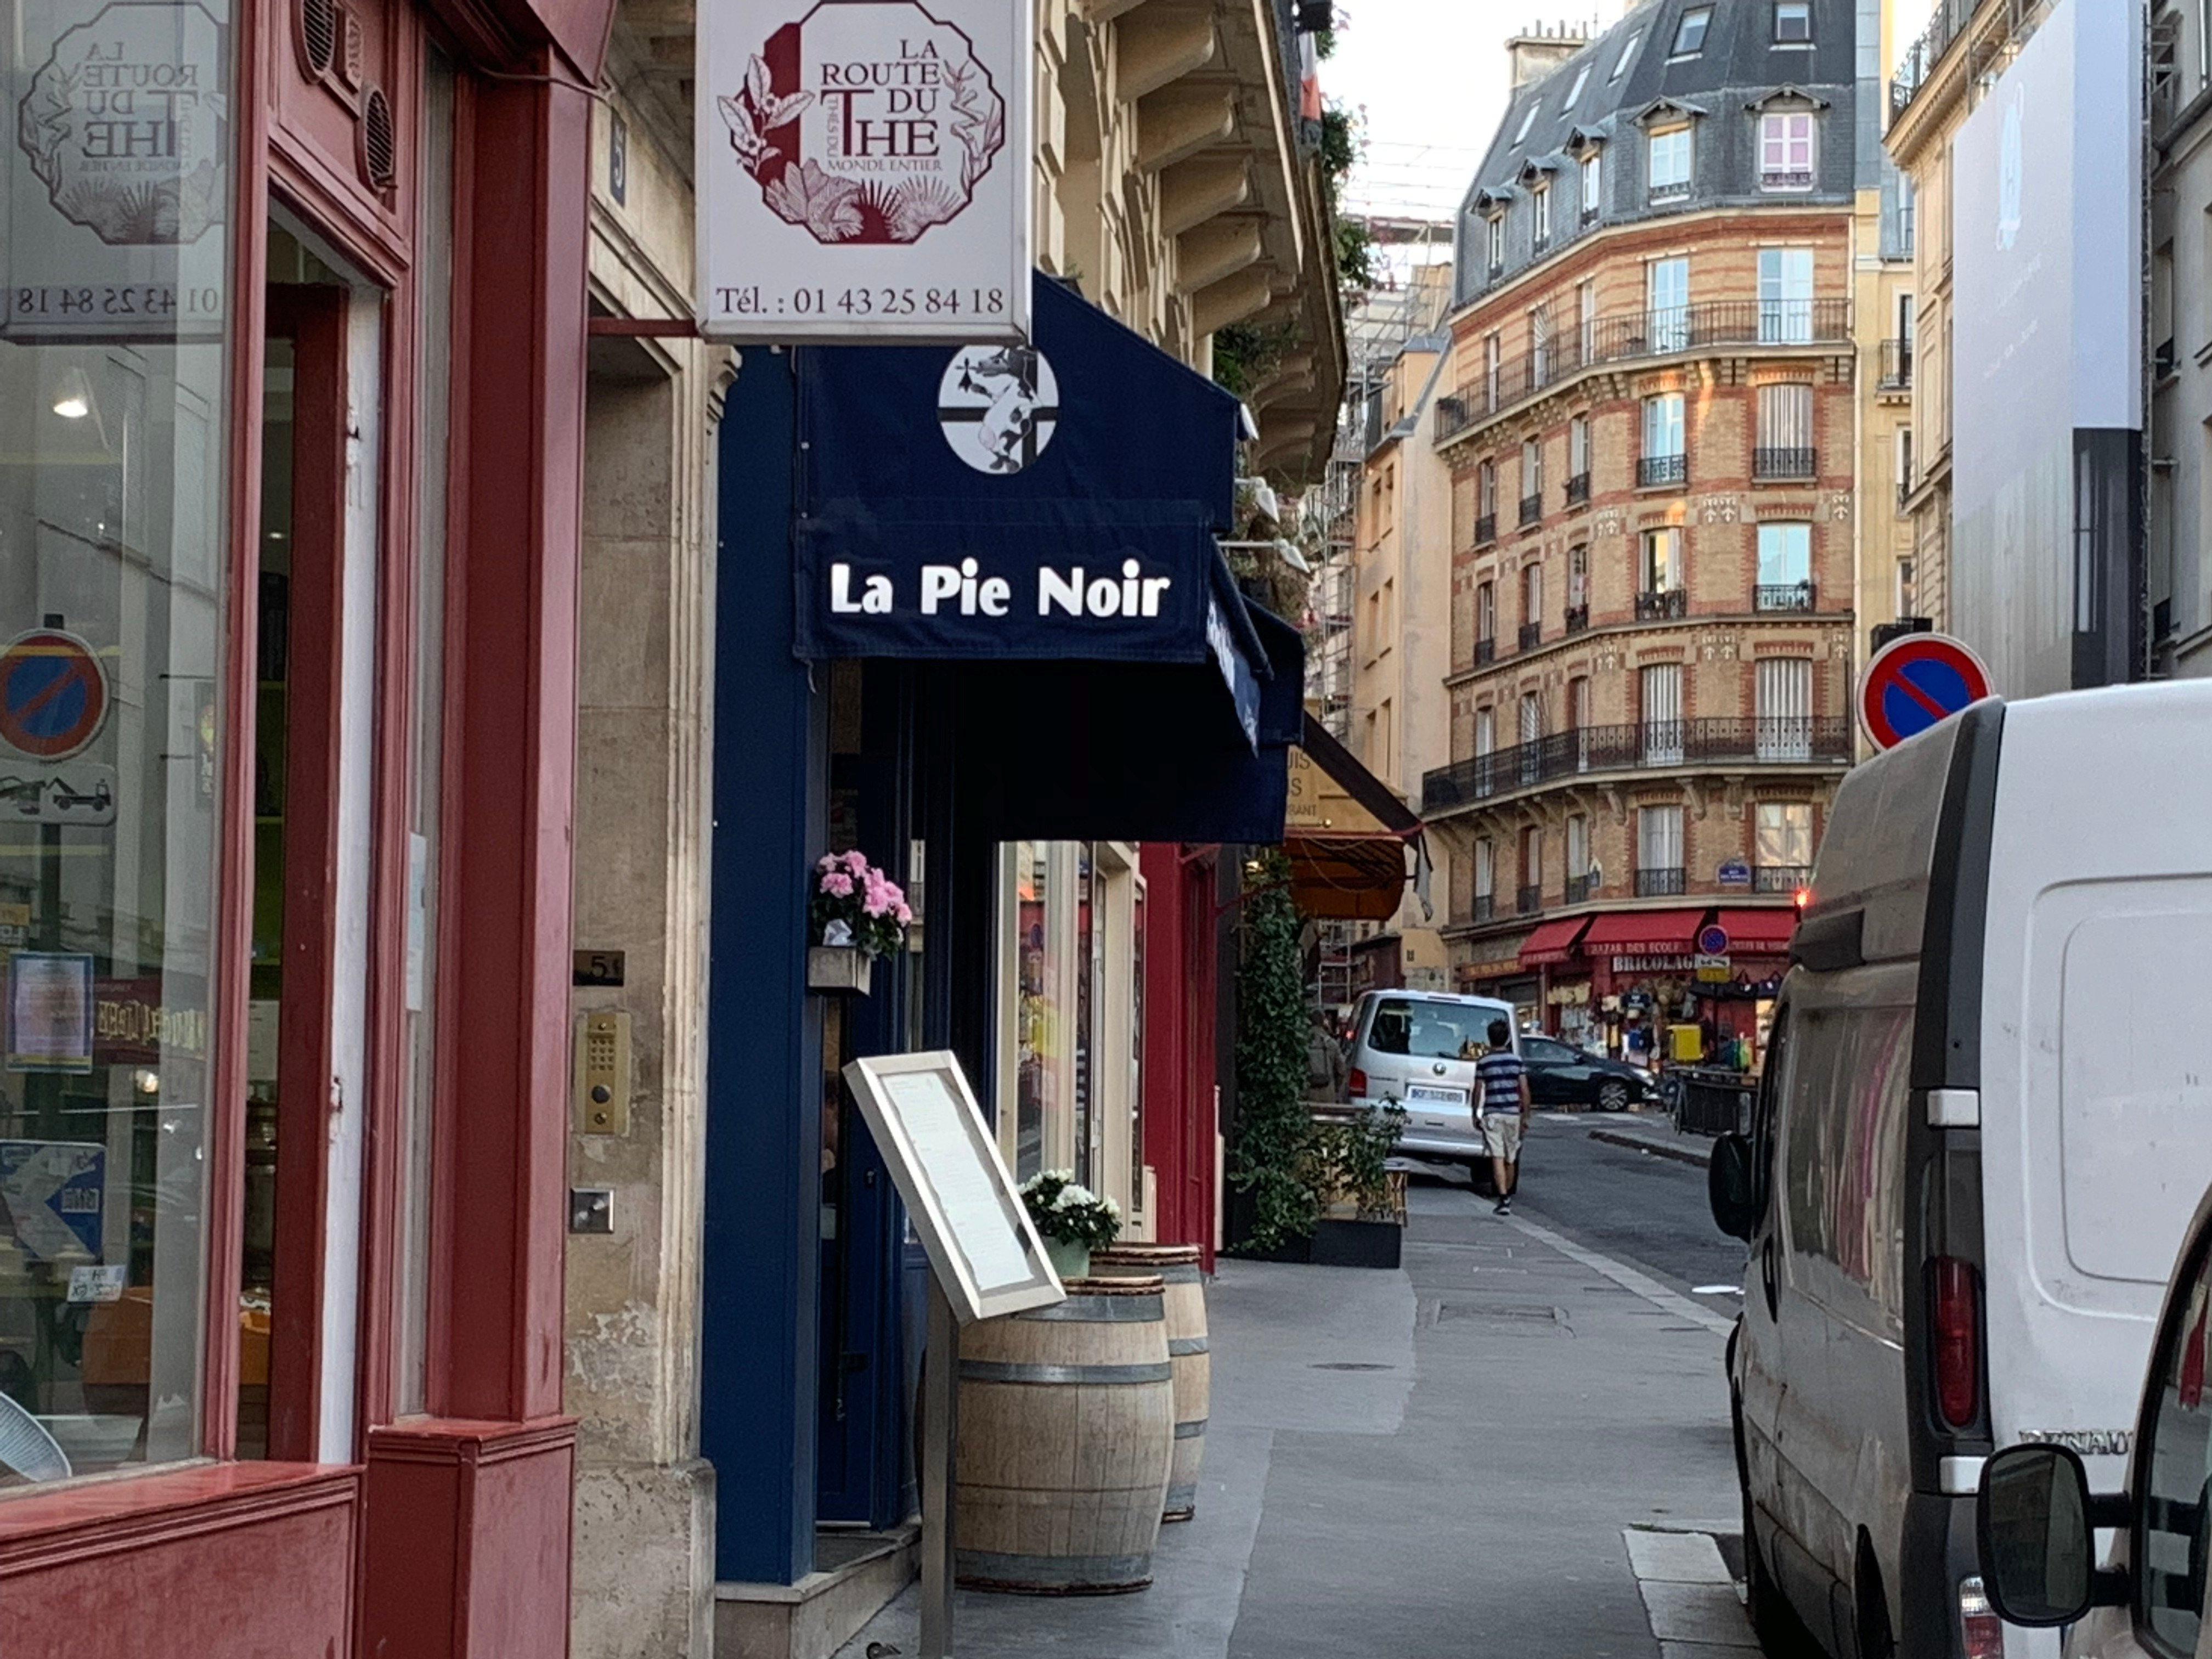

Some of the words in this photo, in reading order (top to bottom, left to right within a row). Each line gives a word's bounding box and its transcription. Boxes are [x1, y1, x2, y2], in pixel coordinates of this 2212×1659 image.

[900, 39, 939, 58] LA
[821, 62, 941, 86] ROUTE
[887, 88, 940, 114] DU
[716, 287, 768, 314] Tél.
[794, 289, 825, 314] 01
[837, 289, 872, 314] 43
[882, 289, 916, 314] 25
[925, 289, 961, 314] 84
[972, 289, 1003, 314] 18
[831, 563, 893, 614] La
[921, 557, 1011, 616] Pie
[1038, 558, 1170, 616] Noir
